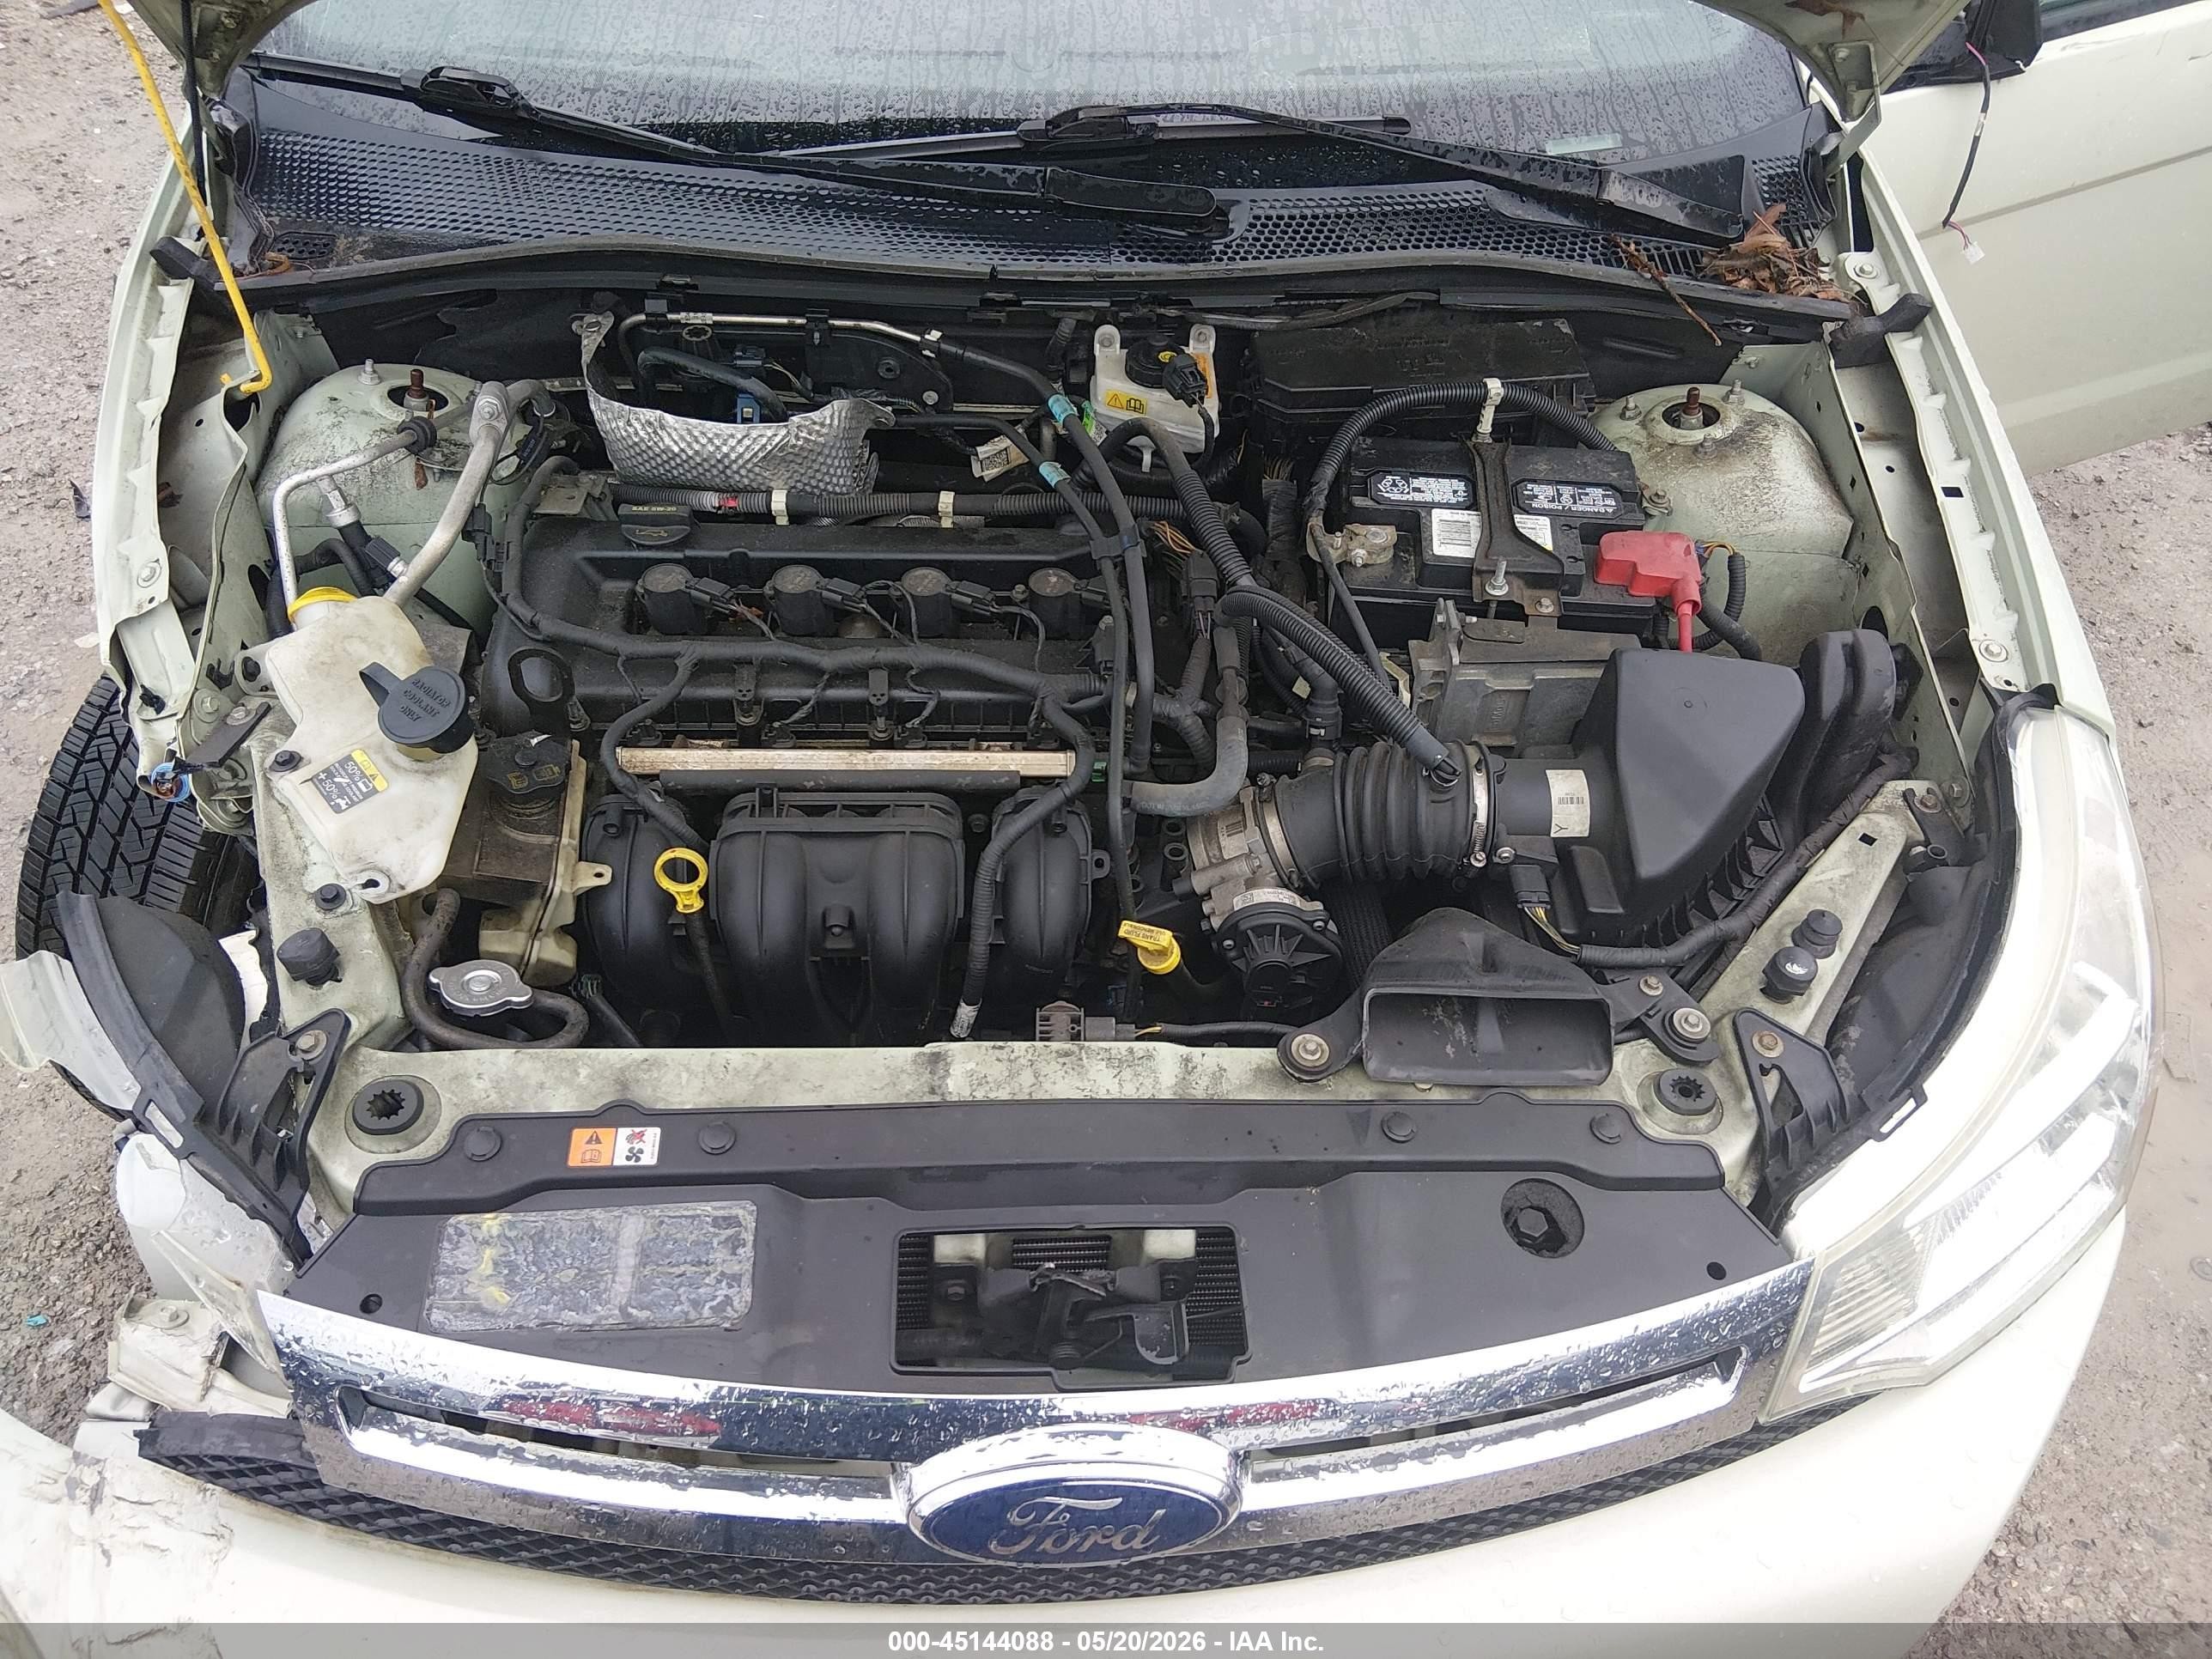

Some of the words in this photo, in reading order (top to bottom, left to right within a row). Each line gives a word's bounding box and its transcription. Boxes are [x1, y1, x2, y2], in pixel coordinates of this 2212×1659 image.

[1571, 505, 1605, 514] DANGER
[404, 689, 441, 718] COOLANT
[412, 678, 452, 708] RADIATOR
[399, 704, 422, 722] ONLY
[344, 761, 364, 781] 50%
[988, 1496, 1167, 1555] Ford
